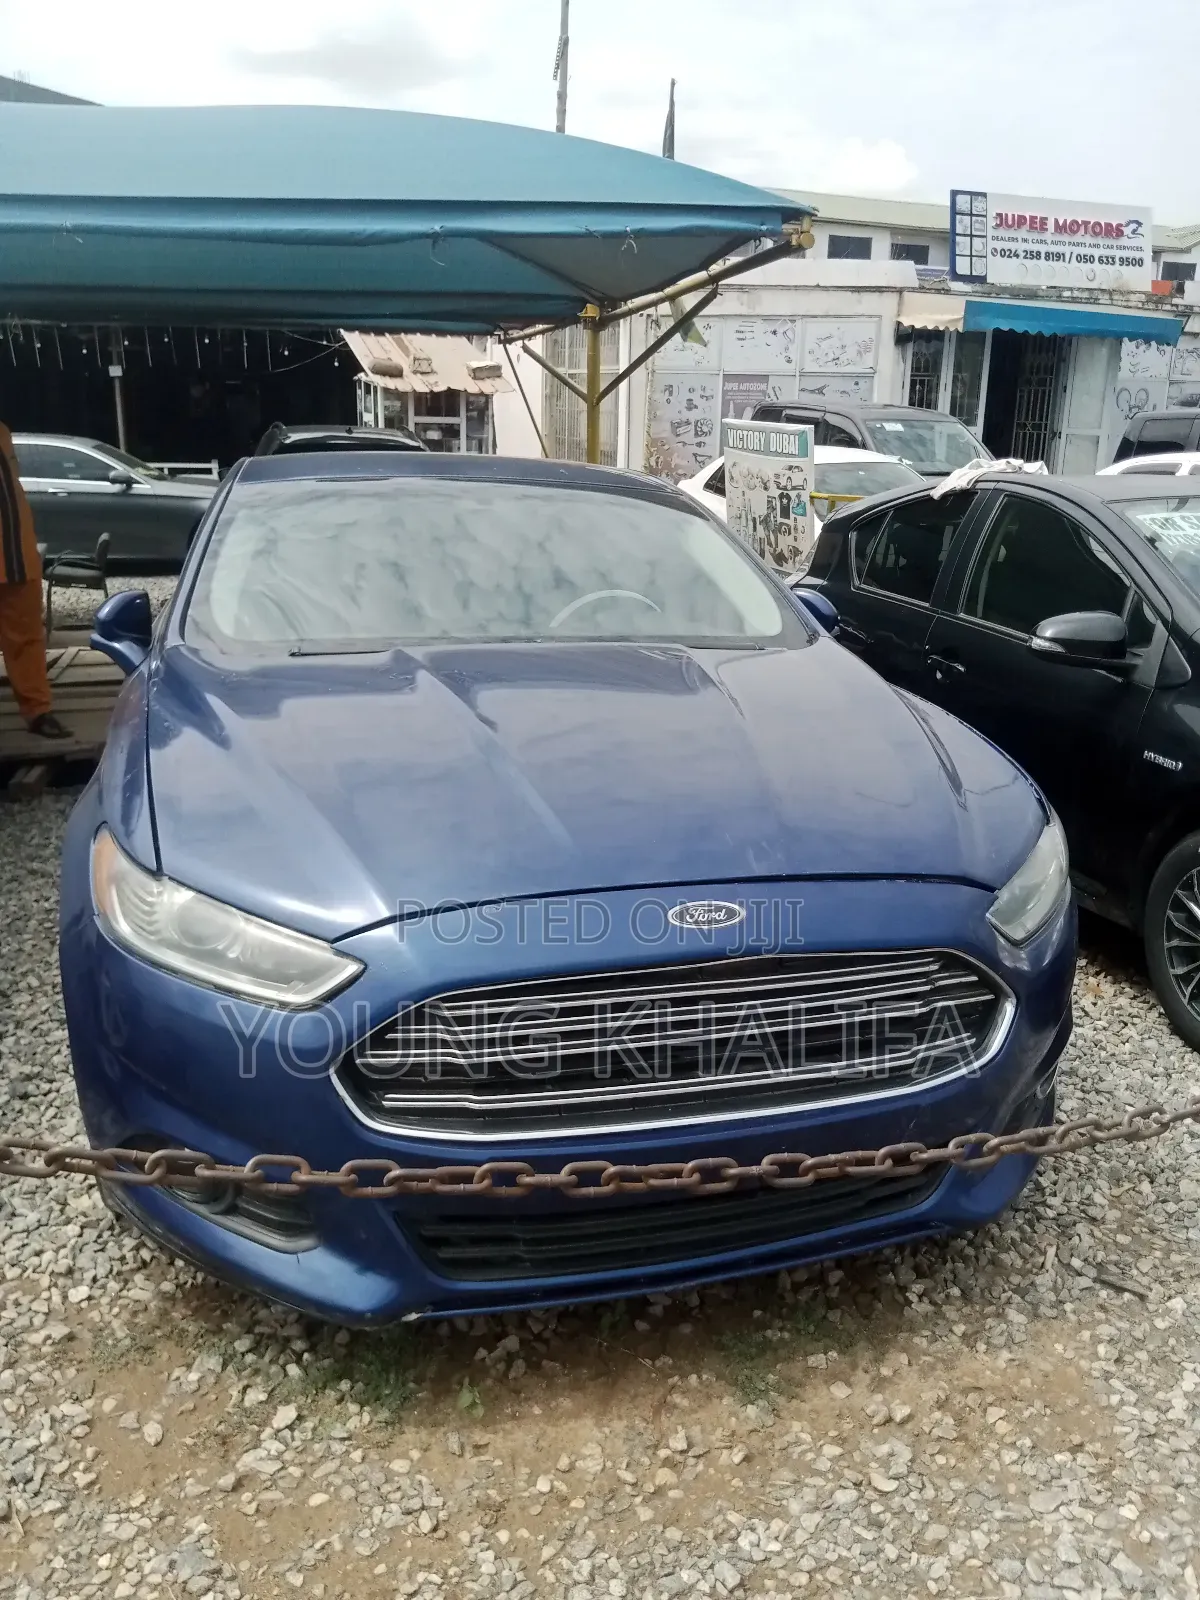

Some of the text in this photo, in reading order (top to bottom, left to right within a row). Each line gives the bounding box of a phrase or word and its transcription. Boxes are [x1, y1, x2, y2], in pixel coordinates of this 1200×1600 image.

[992, 212, 1124, 239] JUPEE MOTORS
[991, 235, 1019, 243] DEALERS
[999, 248, 1020, 259] 024
[1022, 250, 1041, 261] 258
[1044, 251, 1066, 263] 8191
[1075, 253, 1095, 264] 050
[1097, 255, 1116, 266] 633
[1118, 256, 1144, 268] 9500
[727, 428, 798, 455] VICTORY DUBAI
[686, 906, 727, 922] Ford
